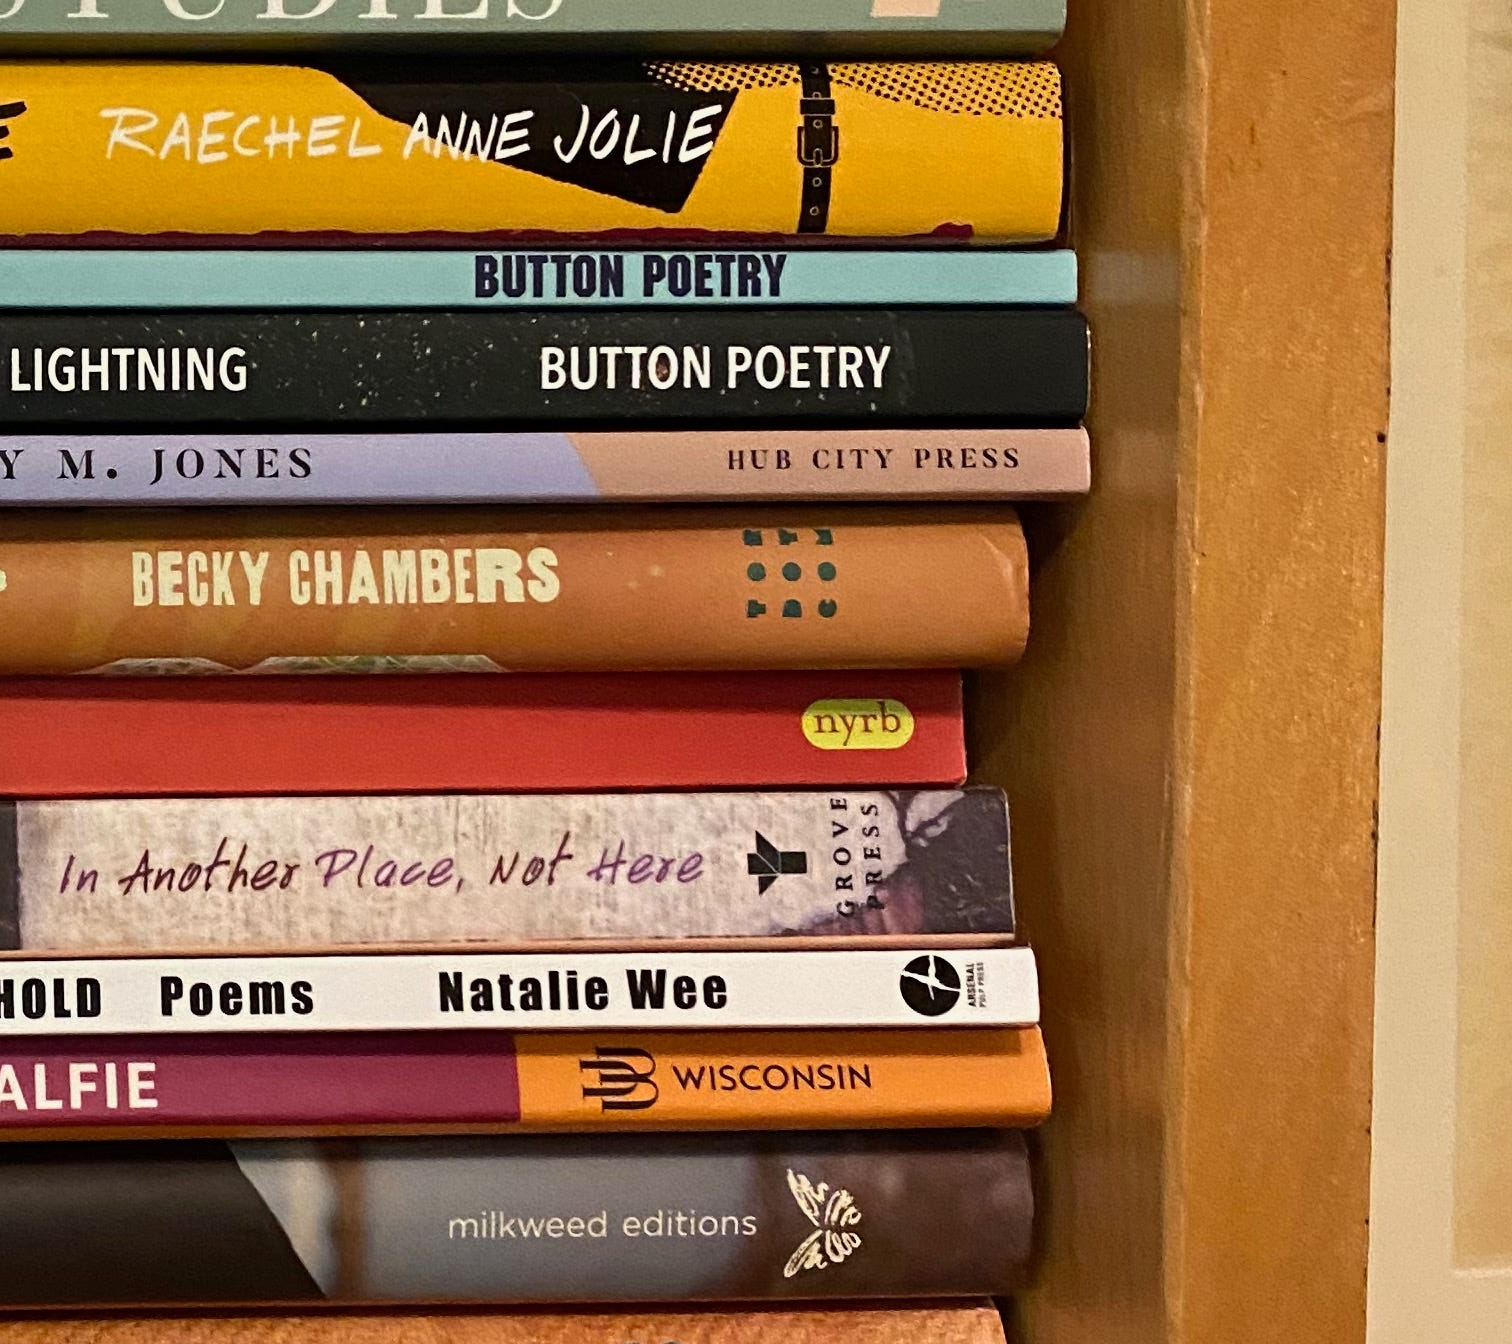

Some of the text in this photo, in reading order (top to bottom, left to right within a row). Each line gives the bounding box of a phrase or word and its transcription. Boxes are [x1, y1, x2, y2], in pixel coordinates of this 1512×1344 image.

[99, 103, 723, 165] RAECHEL ANNE JOLIE
[474, 253, 787, 298] BUTTON POETRY
[11, 347, 248, 392] LIGHTNING
[541, 345, 891, 391] BUTTON POETRY
[57, 448, 118, 480] M.
[149, 447, 313, 486] JONES
[727, 447, 1020, 471] HUB CITY PRESS
[133, 547, 561, 608] BECKY CHAMBERS
[813, 701, 902, 746] nyrb
[59, 831, 705, 896] In Another Place, Not Here
[830, 798, 855, 917] GROVE
[860, 804, 885, 910] PRESS
[160, 975, 315, 1016] Poems
[438, 969, 728, 1012] Natalie Wee
[966, 962, 976, 1007] ARSENAL
[672, 1063, 872, 1091] WISCONSIN
[448, 1209, 758, 1240] milkweed editions
